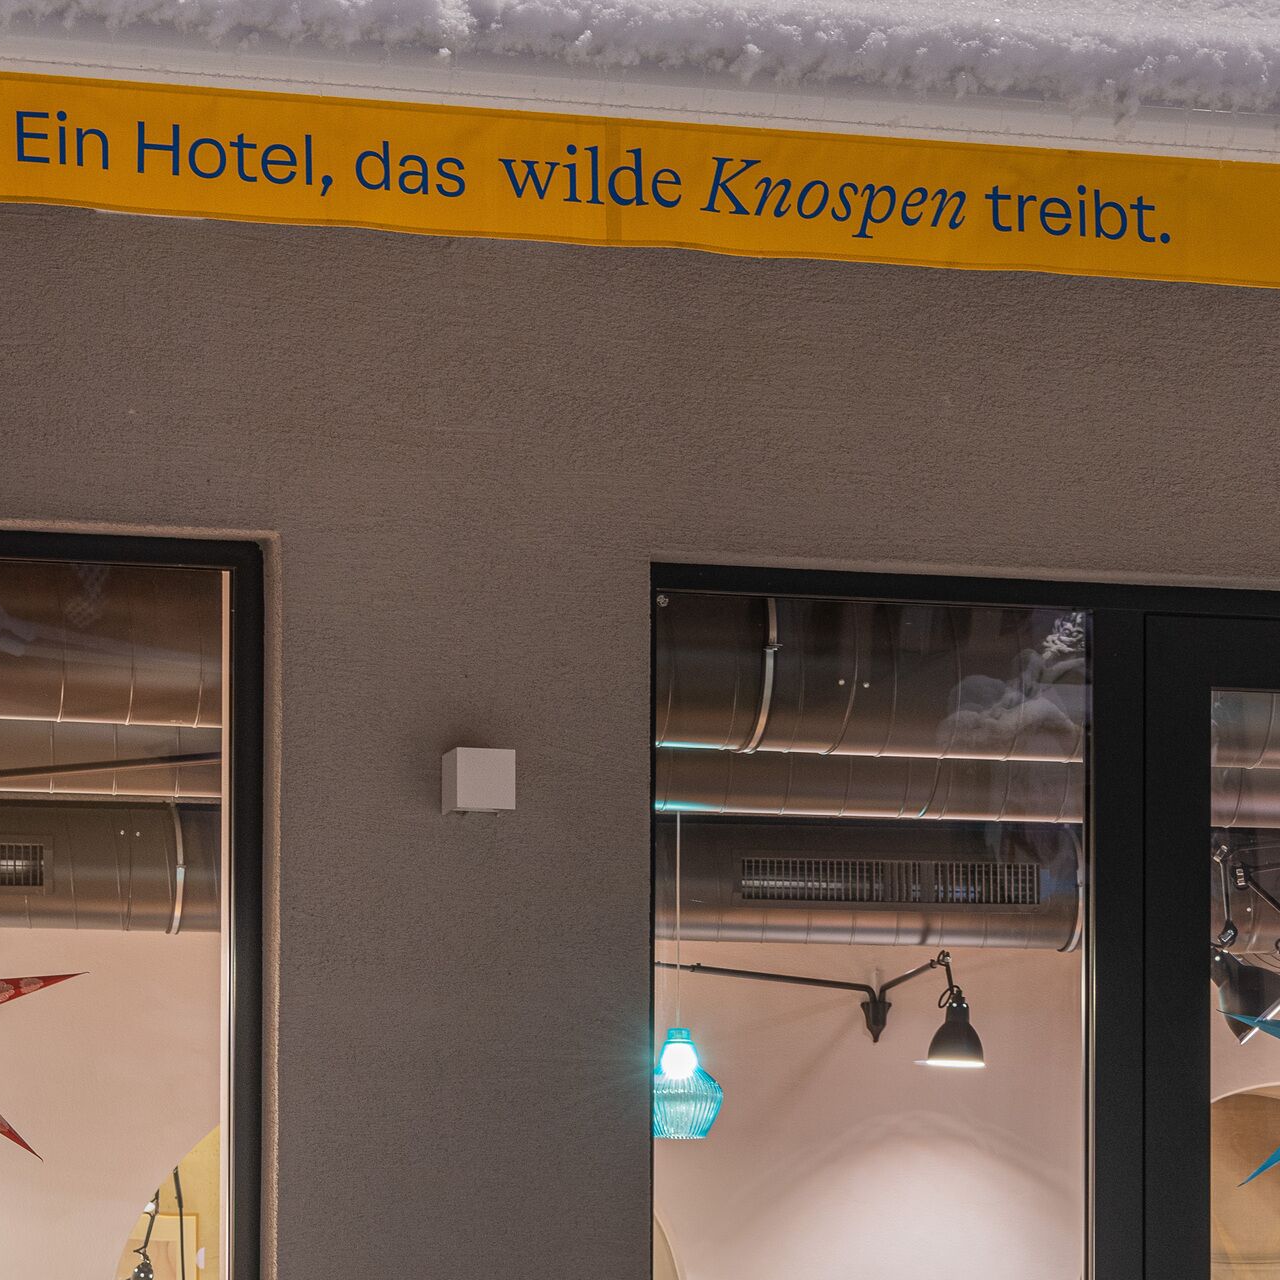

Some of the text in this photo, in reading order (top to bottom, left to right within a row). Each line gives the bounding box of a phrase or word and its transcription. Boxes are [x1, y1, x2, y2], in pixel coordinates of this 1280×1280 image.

[16, 110, 1171, 245] Ein Hotel, das wilde Knospen treibt.
